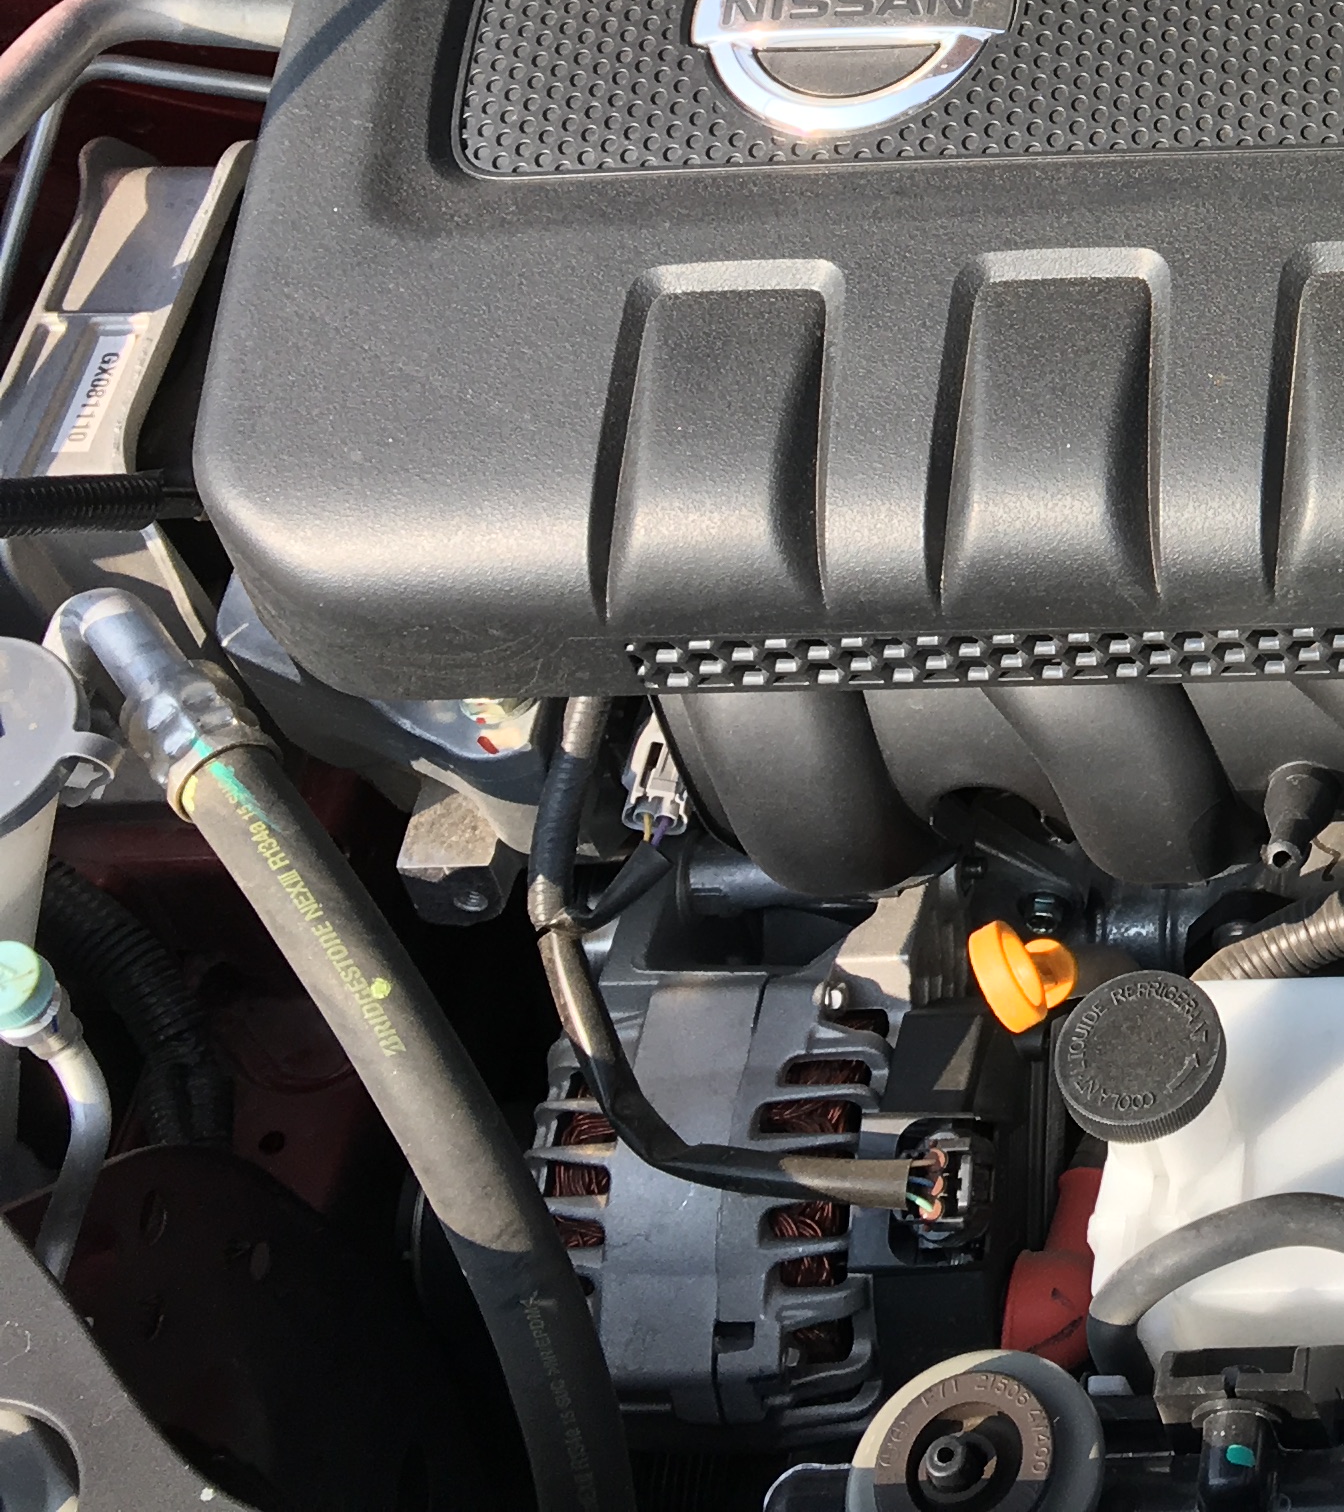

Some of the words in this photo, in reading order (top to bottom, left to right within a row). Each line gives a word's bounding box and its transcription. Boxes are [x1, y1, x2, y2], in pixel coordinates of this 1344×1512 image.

[67, 351, 120, 443] GX081110
[244, 818, 290, 874] R134a
[309, 920, 406, 1058] BRIDGESTONE
